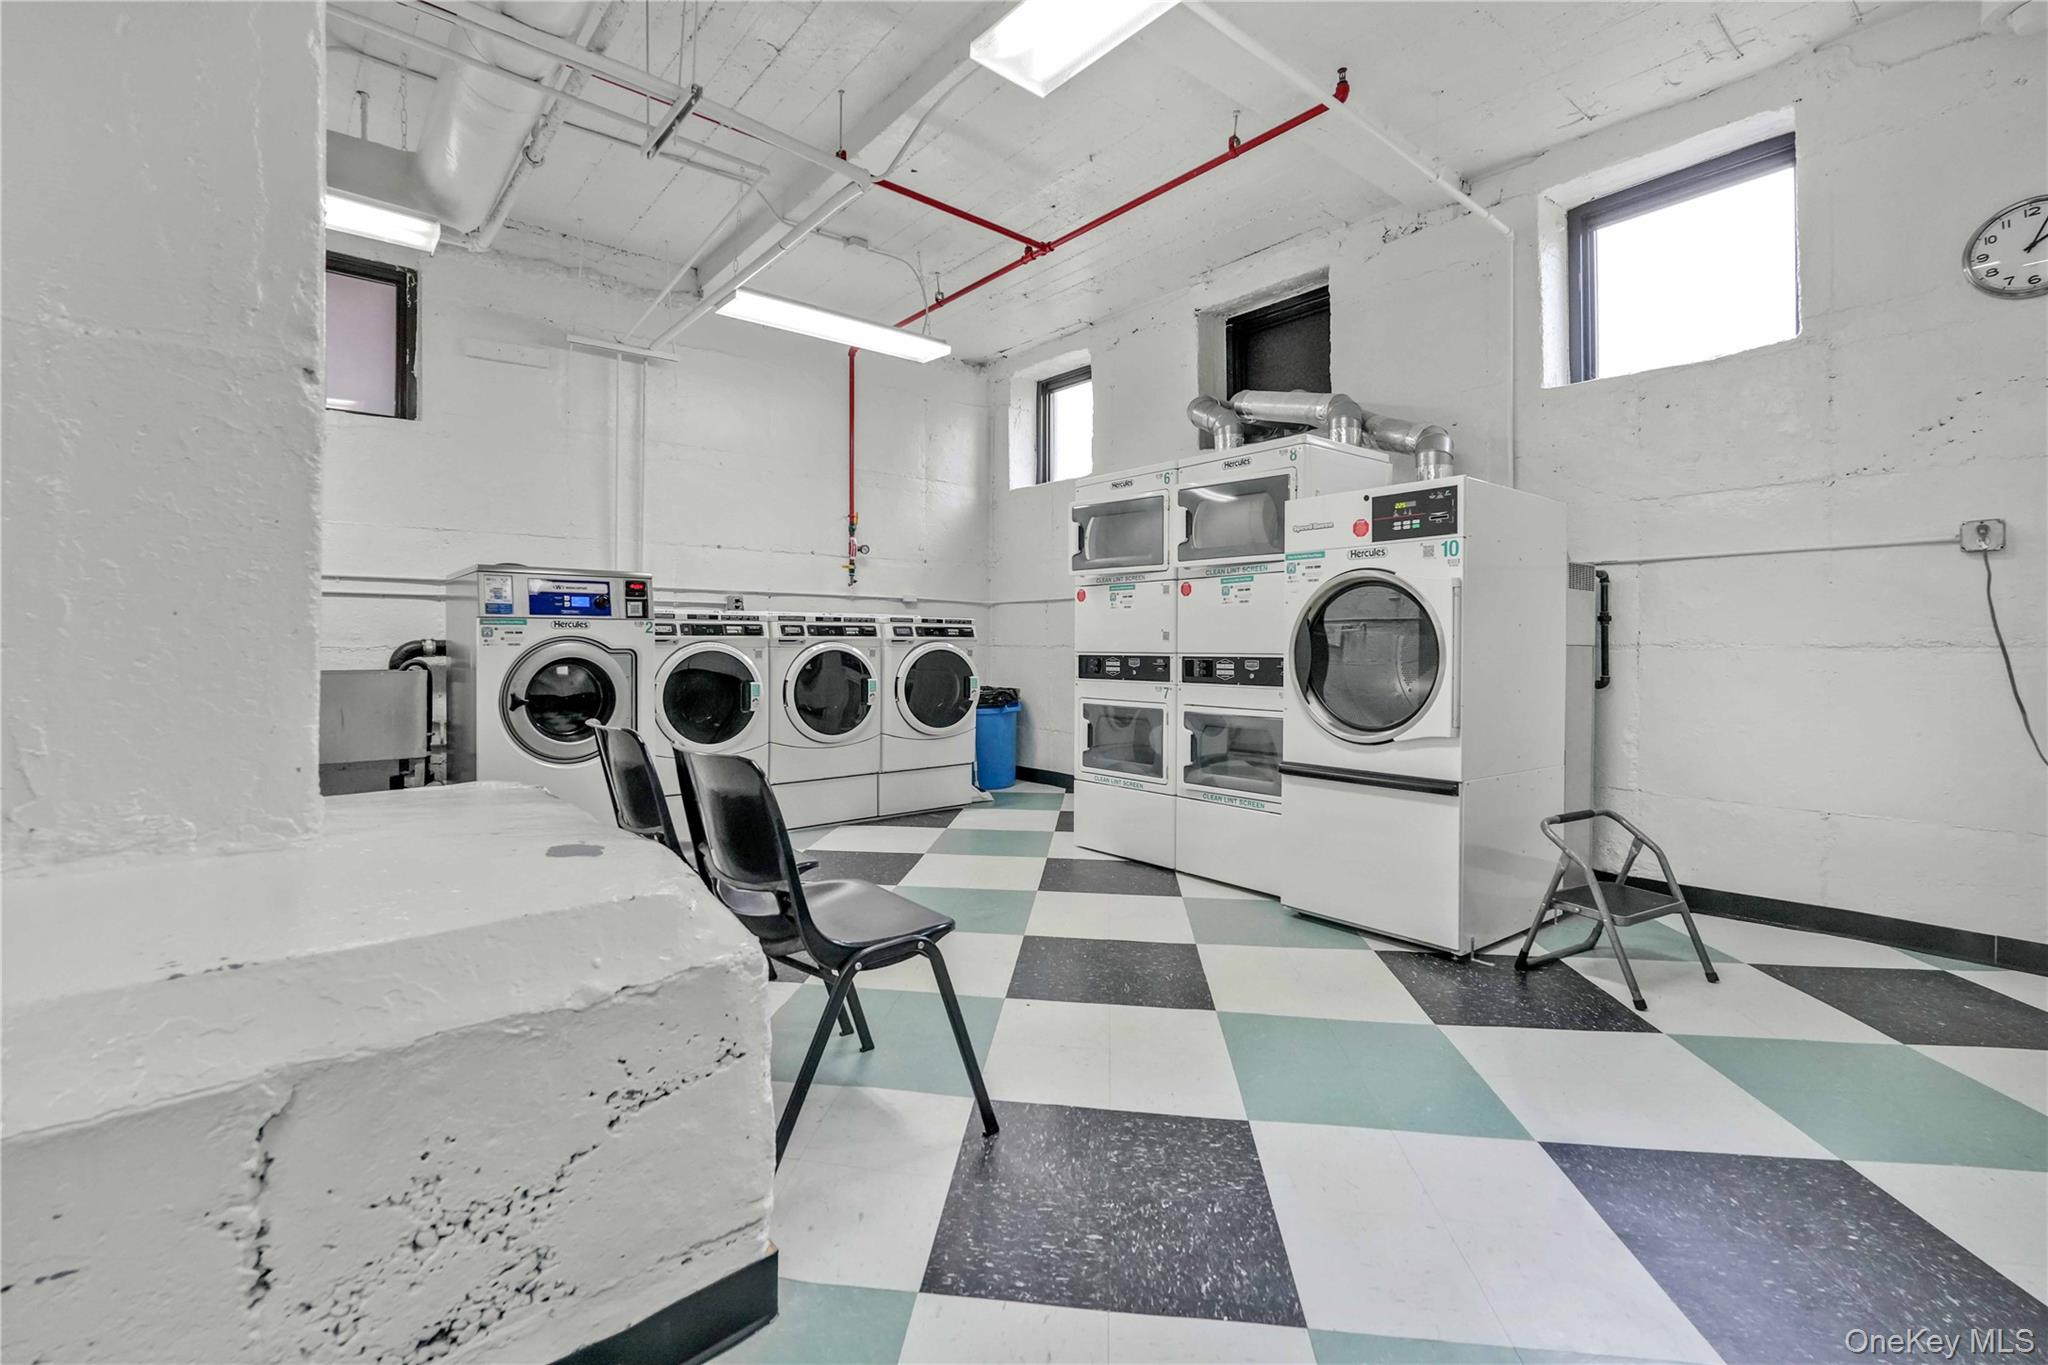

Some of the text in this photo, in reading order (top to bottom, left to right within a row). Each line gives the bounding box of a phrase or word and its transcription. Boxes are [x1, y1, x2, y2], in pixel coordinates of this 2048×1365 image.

[2023, 206, 2041, 218] 12
[2001, 219, 2011, 230] 11
[1984, 234, 1998, 245] 10
[1976, 253, 1990, 263] 9
[1985, 267, 1999, 278] 8
[2003, 275, 2016, 286] 7
[2027, 274, 2042, 285] 6
[1289, 448, 1297, 461] 8
[1223, 457, 1251, 469] Hercules
[1163, 471, 1170, 484] 6
[1111, 479, 1133, 489] Hercules
[1350, 547, 1386, 558] Hercules
[1441, 539, 1459, 557] 10
[1205, 568, 1226, 576] CLEAN
[1242, 564, 1268, 573] SCREEN
[553, 620, 589, 629] Hercules
[645, 621, 653, 634] 2
[1163, 687, 1169, 699] 7
[1094, 775, 1110, 783] CLEAN
[1123, 780, 1144, 789] SCREEN
[1202, 792, 1265, 809] CLEAN LINT SCREEN
